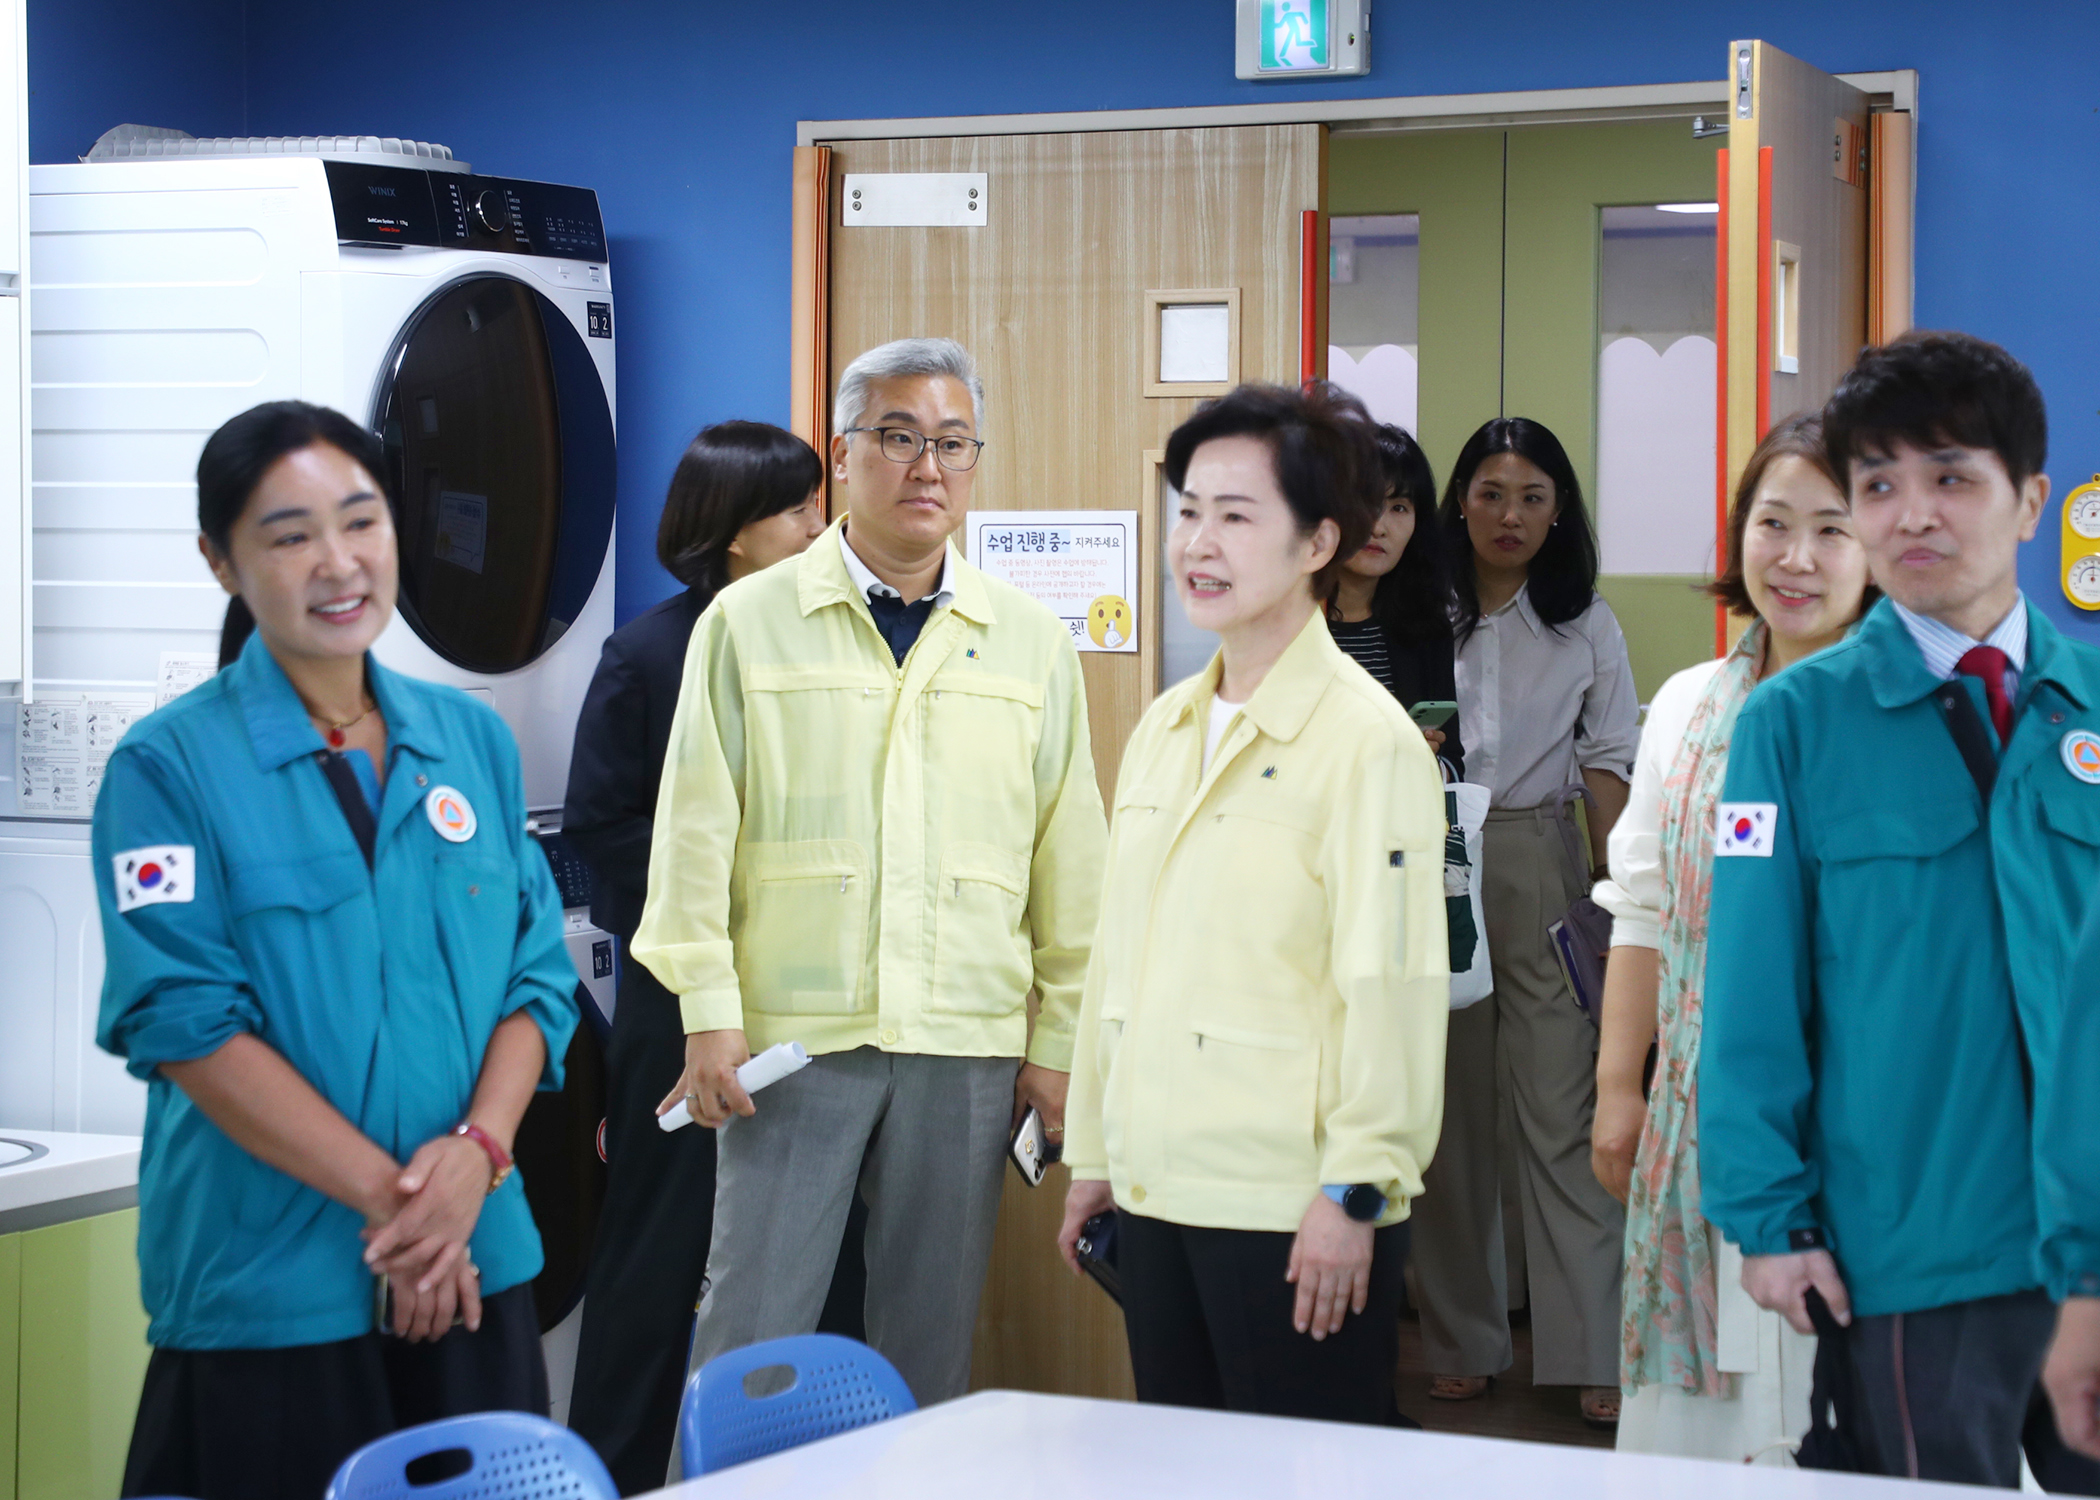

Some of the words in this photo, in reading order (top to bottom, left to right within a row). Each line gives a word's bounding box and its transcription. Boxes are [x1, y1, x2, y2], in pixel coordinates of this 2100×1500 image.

[368, 186, 396, 197] WINIX
[590, 316, 598, 330] 10
[602, 317, 608, 330] 2
[988, 532, 1013, 552] 수업
[1017, 532, 1045, 552] 진행
[1049, 532, 1070, 552] 중~
[1075, 536, 1120, 548] 지켜주세요
[1070, 620, 1085, 636] 쉿!
[594, 956, 603, 970] 10
[605, 954, 610, 968] 2
